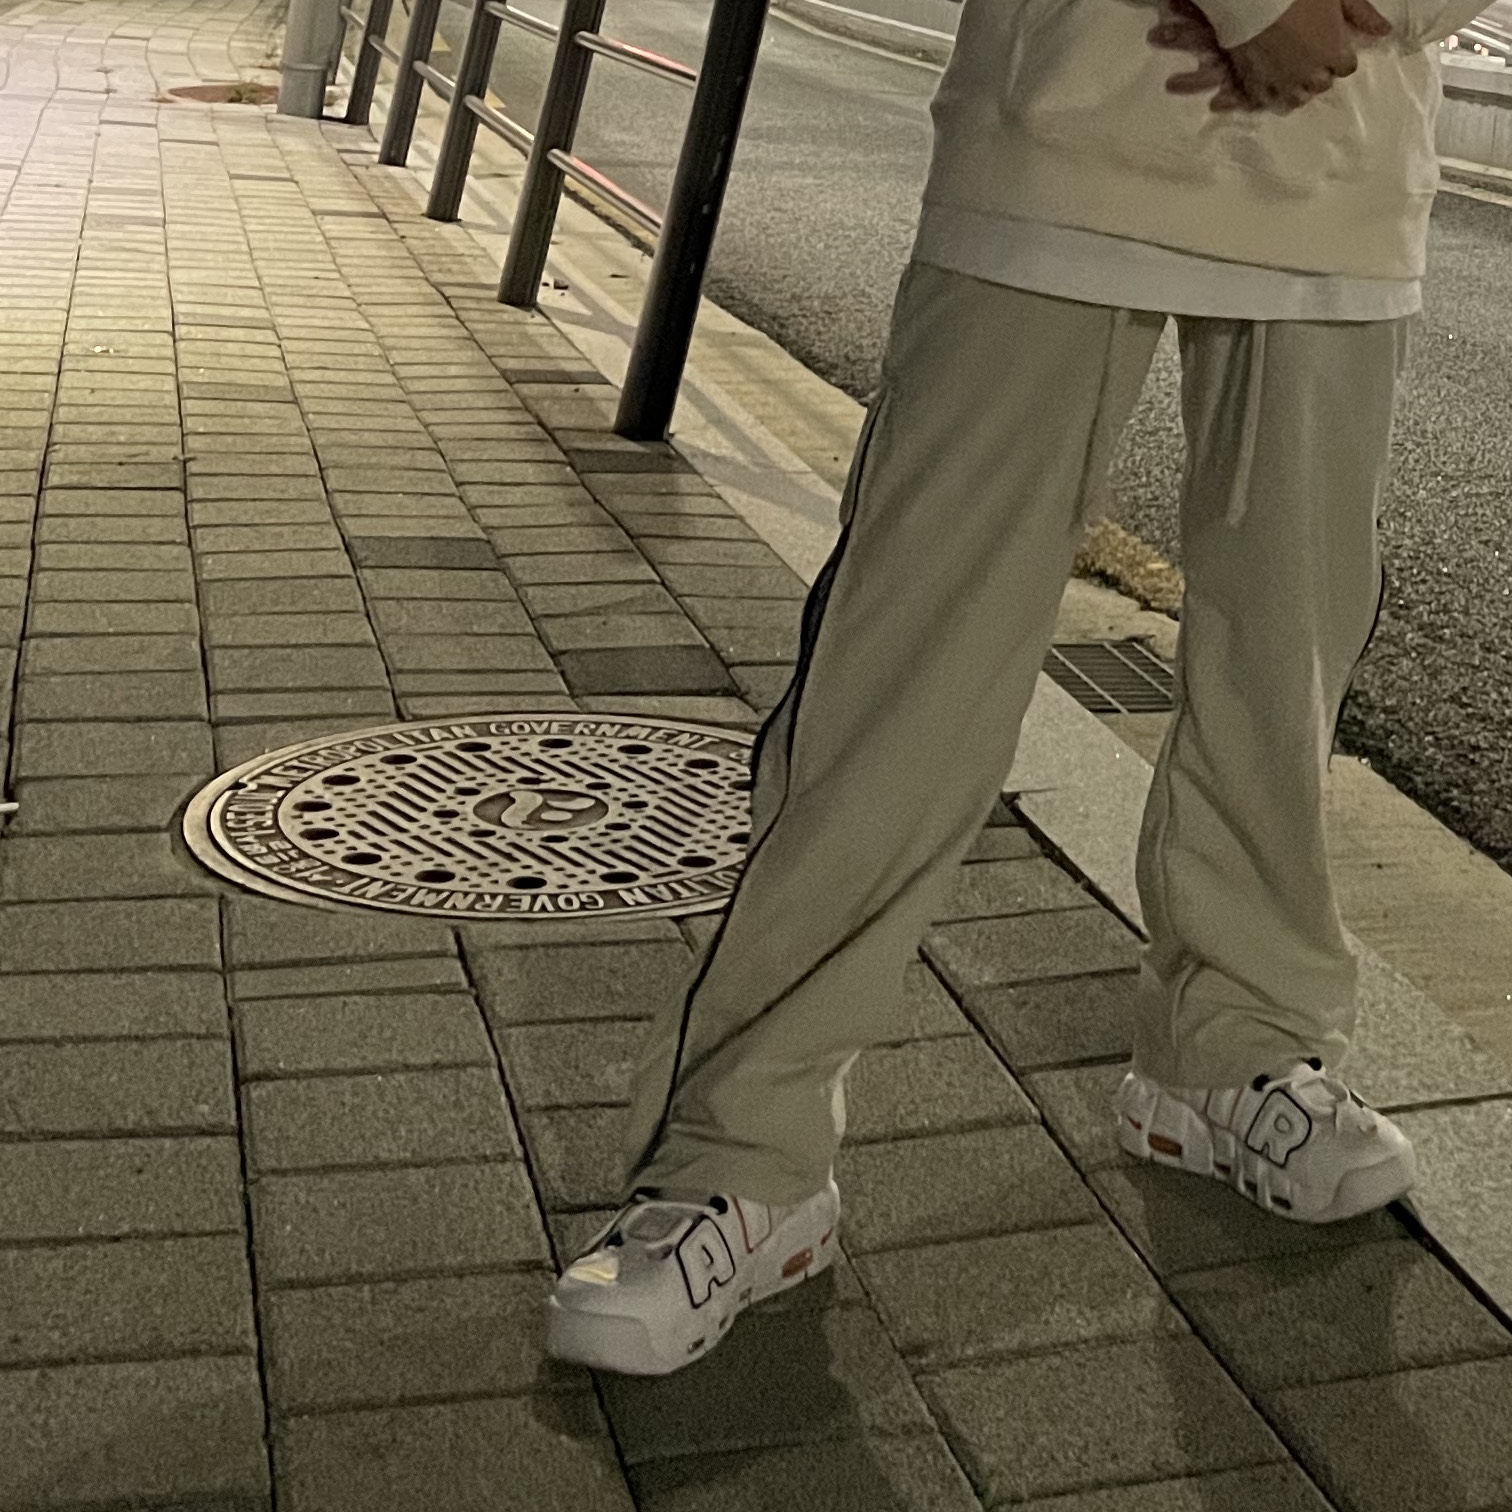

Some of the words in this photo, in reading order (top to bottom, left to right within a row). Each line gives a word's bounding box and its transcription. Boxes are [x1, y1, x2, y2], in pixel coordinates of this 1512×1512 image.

[256, 725, 478, 788] METROPOLITAN
[489, 721, 720, 749] GOVERNMENT
[331, 878, 604, 912] GOVERNMENT
